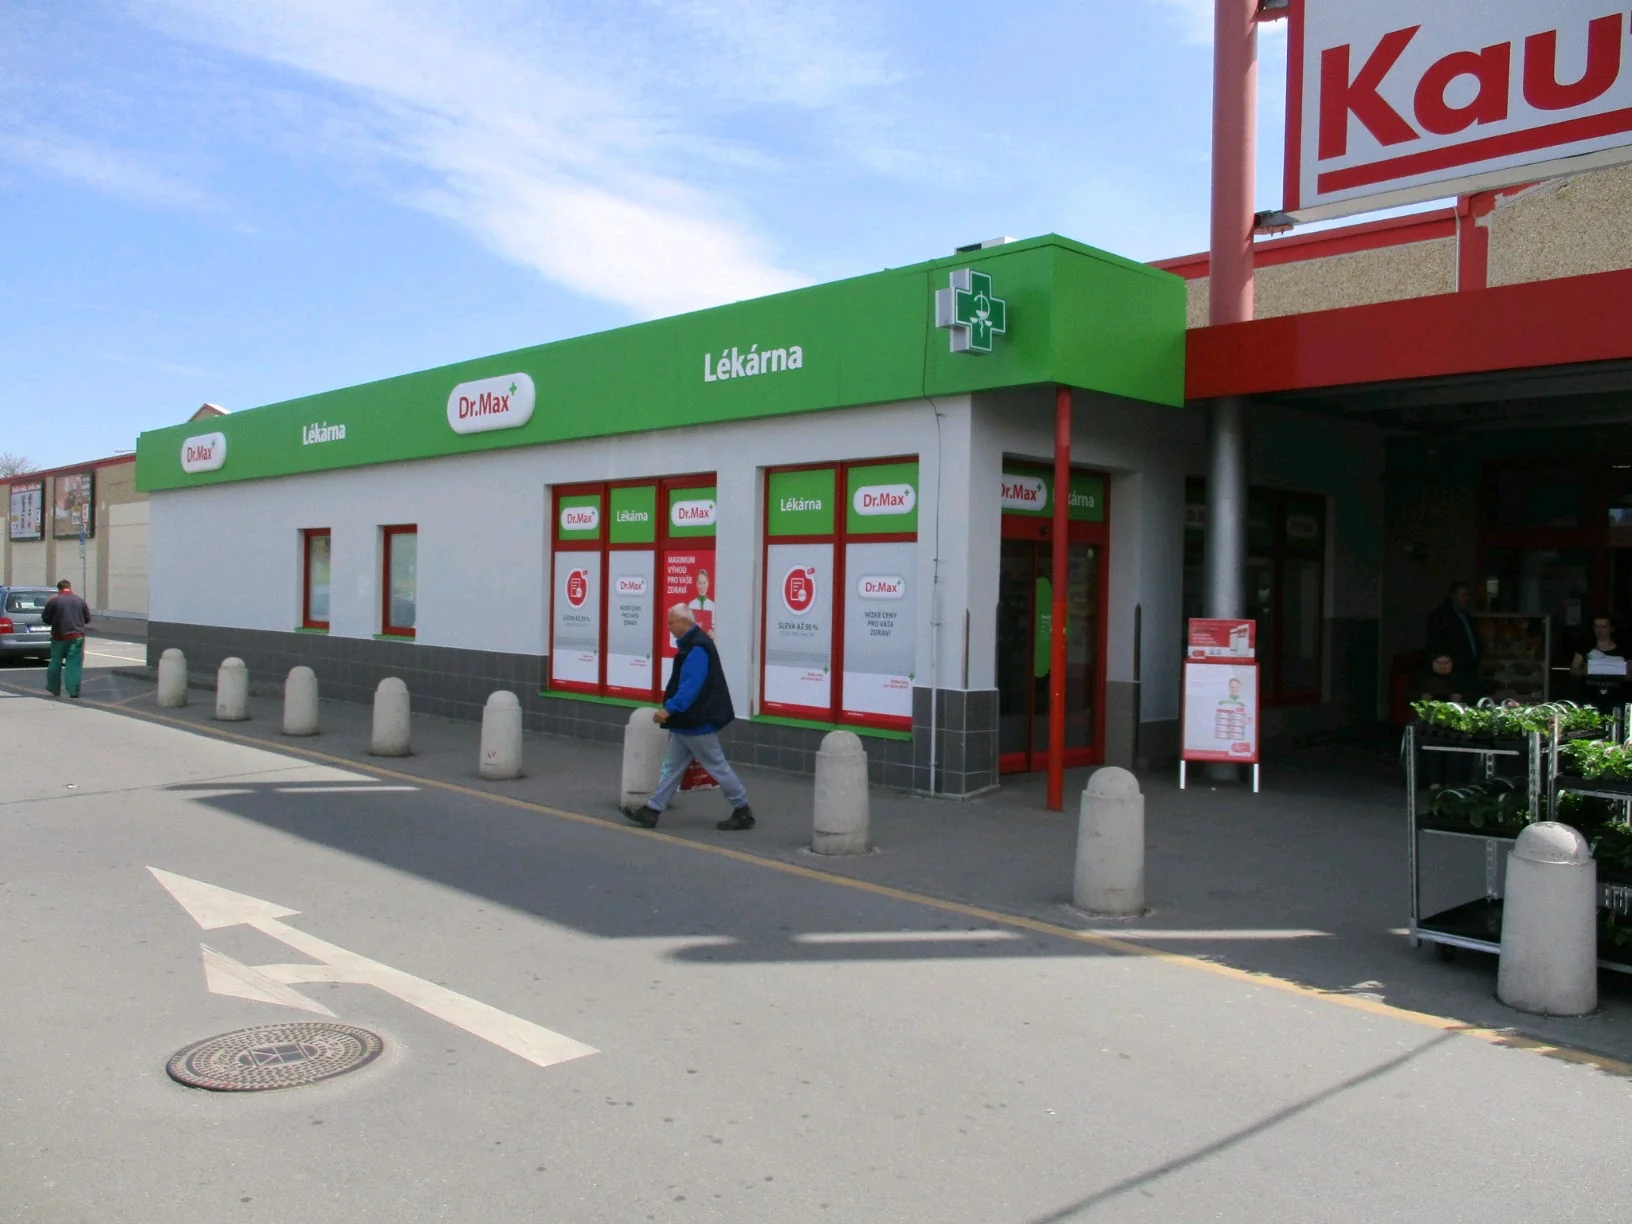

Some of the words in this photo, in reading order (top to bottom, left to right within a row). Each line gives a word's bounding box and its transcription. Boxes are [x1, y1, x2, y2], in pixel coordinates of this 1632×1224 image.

[1318, 12, 1632, 161] Kau
[704, 342, 803, 383] Lékárna
[458, 391, 510, 418] Dr.Max
[302, 421, 346, 445] Lékárna
[186, 444, 213, 463] Dr.Max
[780, 495, 822, 512] Lékárna
[863, 491, 905, 508] Dr.Max
[566, 512, 593, 524] Dr.Max
[616, 510, 649, 523] Lékárna
[678, 507, 709, 520] Dr.Max
[667, 556, 696, 564] MAXIMUM
[667, 565, 687, 574] VÝHOD
[619, 580, 642, 591] Dr.Max
[667, 576, 678, 584] PRO
[679, 575, 693, 584] VAŠE
[865, 581, 898, 593] Dr.Max
